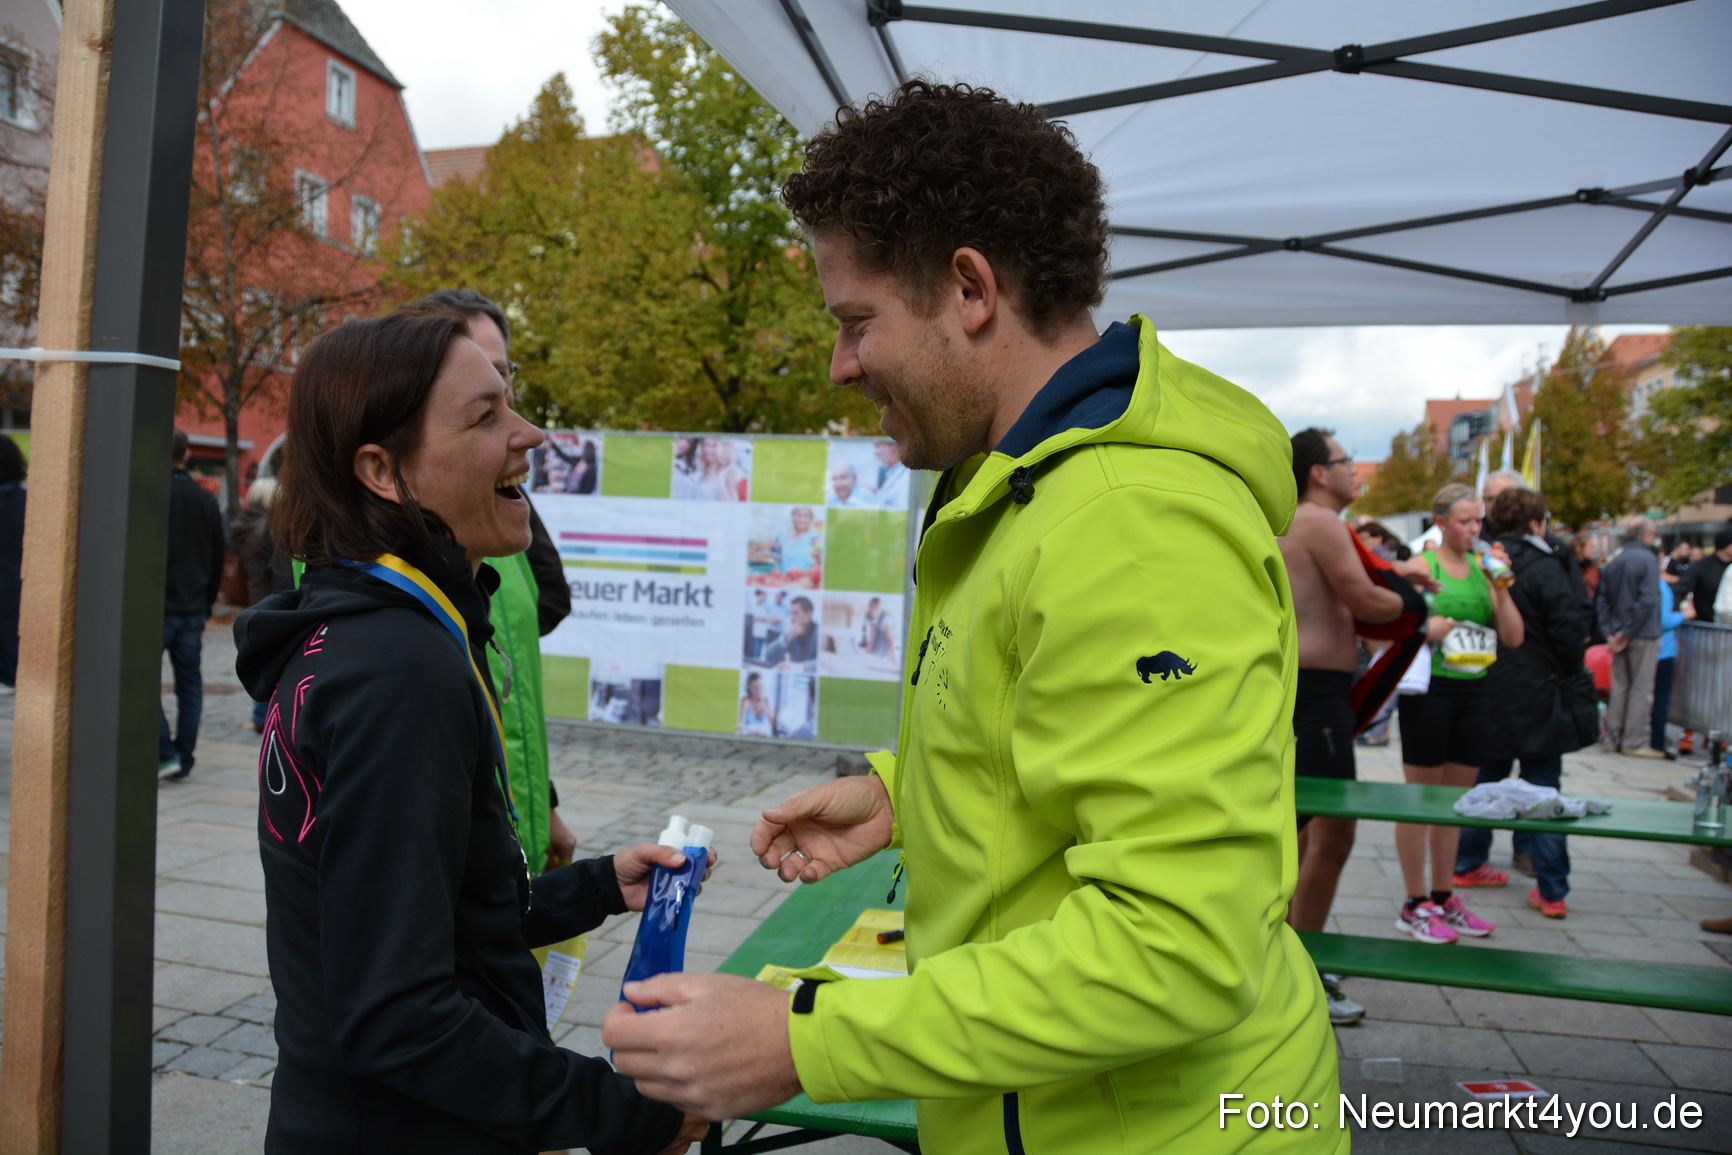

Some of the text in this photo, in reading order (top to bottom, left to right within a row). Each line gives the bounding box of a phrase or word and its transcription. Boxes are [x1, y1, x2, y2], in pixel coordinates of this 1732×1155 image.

[570, 579, 714, 608] euer Markt
[571, 609, 607, 621] kaufen
